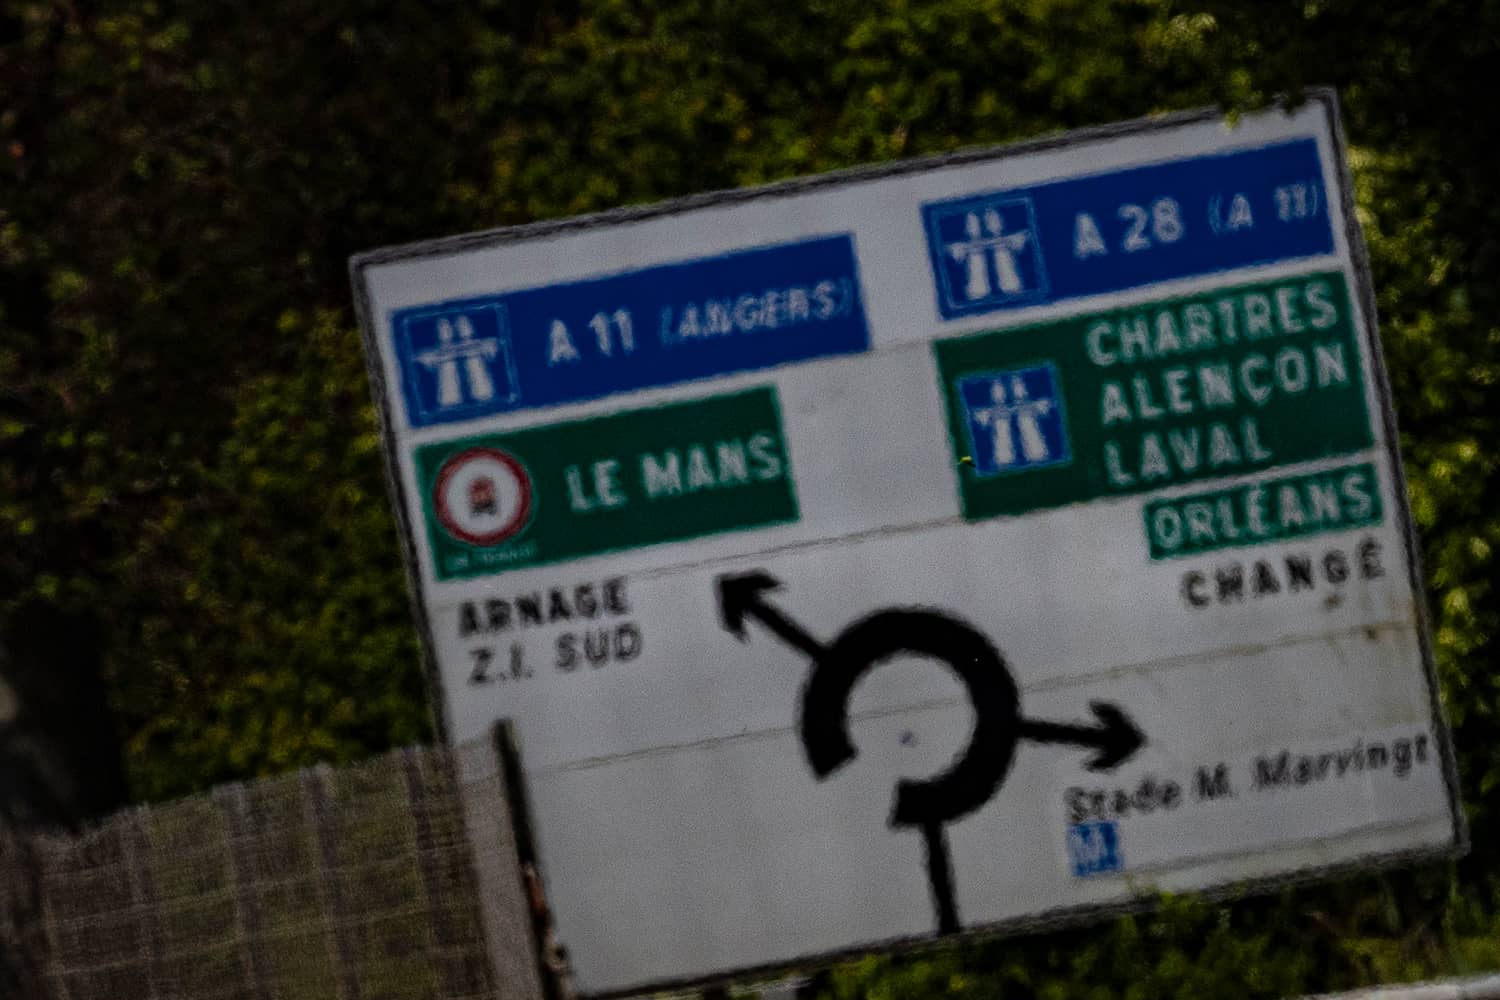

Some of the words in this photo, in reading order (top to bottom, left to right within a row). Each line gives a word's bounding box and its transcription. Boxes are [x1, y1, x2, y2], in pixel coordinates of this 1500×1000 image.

[1073, 211, 1108, 259] A
[1116, 195, 1184, 254] 28
[548, 317, 581, 367] A
[588, 308, 636, 358] 11
[657, 276, 853, 348] (ANGERS)
[1085, 281, 1338, 367] CHARTRES
[1101, 342, 1350, 425] ALENÇON
[566, 459, 627, 513] LE
[640, 430, 783, 499] MANS
[1104, 417, 1273, 486] LAVAL
[1153, 471, 1375, 549] ORLÉANS
[458, 574, 632, 639] ARNAGE
[554, 622, 644, 674] SUD
[1064, 775, 1183, 824] Stade
